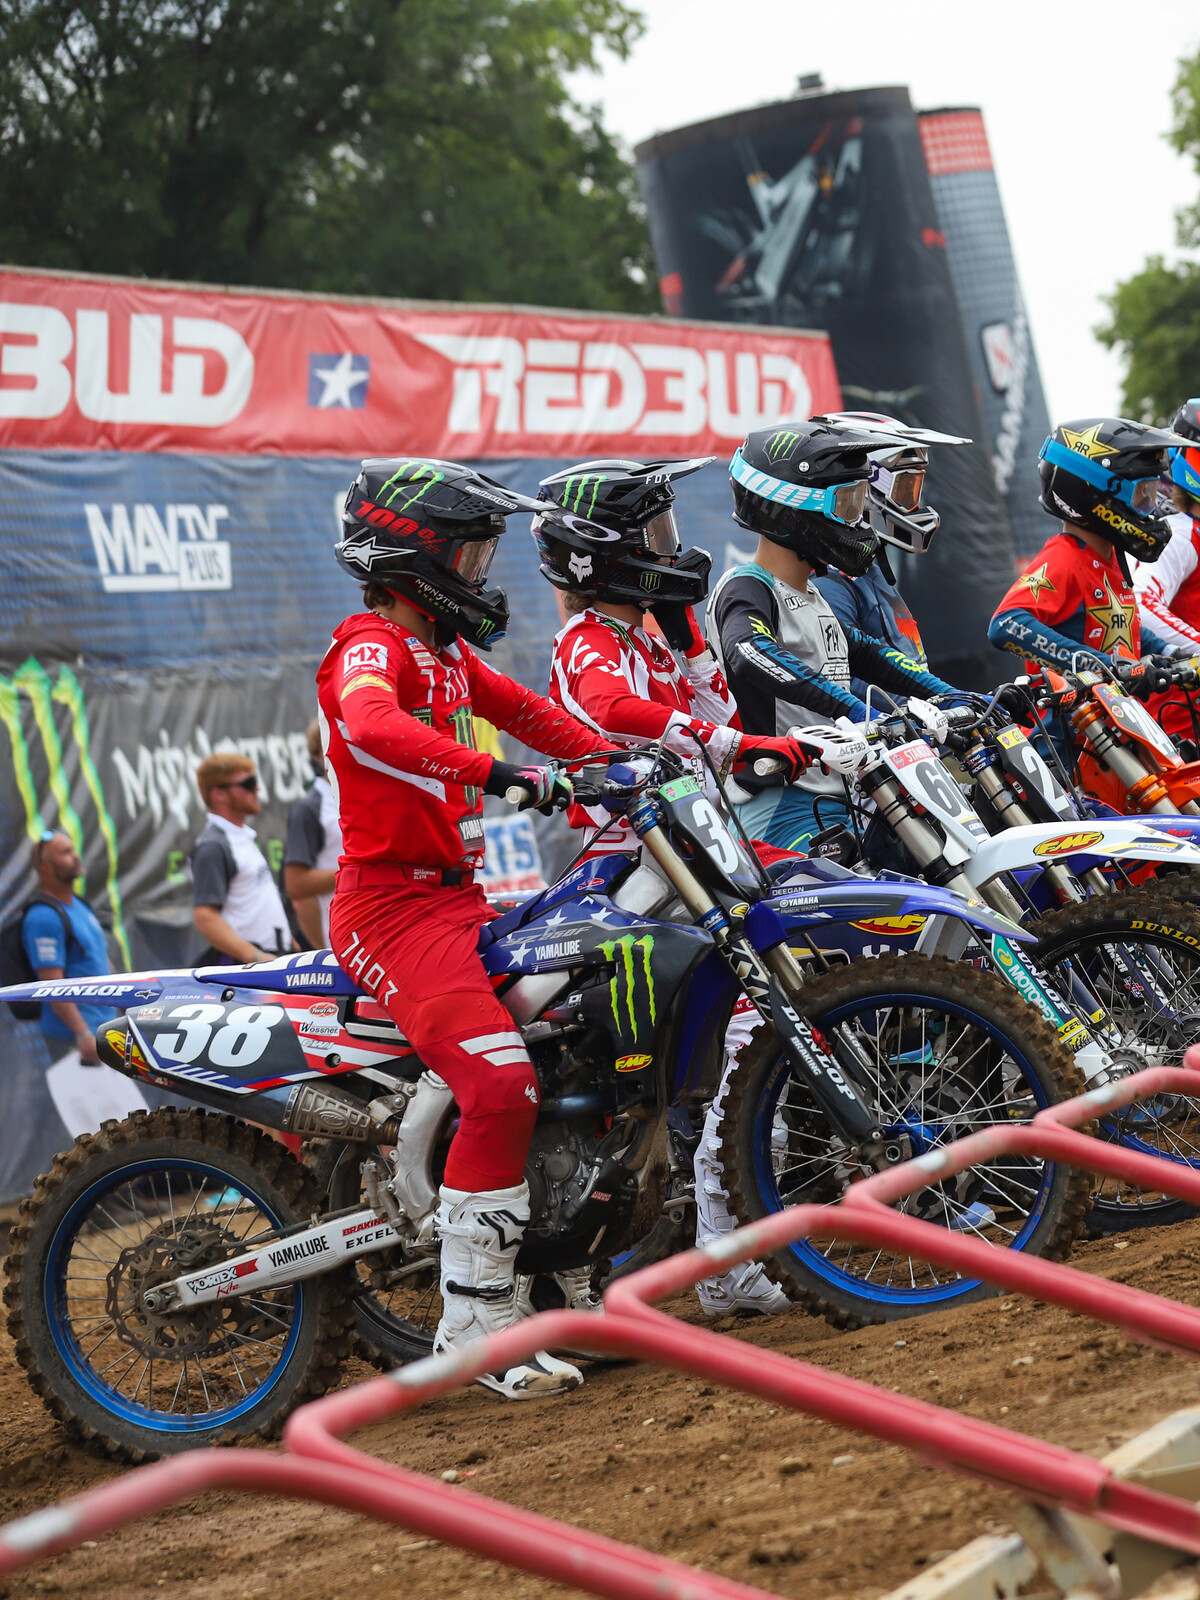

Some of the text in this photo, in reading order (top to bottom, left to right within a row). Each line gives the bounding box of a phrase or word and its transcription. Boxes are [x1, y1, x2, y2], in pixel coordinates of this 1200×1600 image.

[415, 332, 812, 438] REDBUD
[646, 473, 672, 485] FOX
[354, 500, 448, 554] 100%
[1091, 503, 1157, 546] ROCKSTAR
[184, 547, 224, 582] PLUS
[415, 578, 460, 614] MONSTER
[998, 616, 1032, 641] FLY
[349, 646, 381, 664] MX
[421, 757, 461, 780] THOR
[1035, 832, 1103, 856] FMF
[772, 885, 805, 896] DEEGAN
[788, 896, 819, 907] YAMAHA
[534, 939, 581, 961] YAMALUBE
[286, 972, 333, 987] YAMAHA
[341, 931, 399, 1006] THOR
[1006, 938, 1071, 1015] DUNLOP
[32, 985, 135, 998] DUNLOP
[153, 1003, 285, 1068] 38
[615, 1054, 652, 1072] FMF
[781, 1005, 856, 1100] DUNLOP
[789, 1035, 822, 1076] BRAKING
[342, 1215, 388, 1237] BRAKING
[346, 1227, 394, 1250] EXCEL
[268, 1235, 330, 1268] YAMALUBE
[186, 1265, 239, 1295] VORTEX
[216, 1281, 240, 1298] Kite
